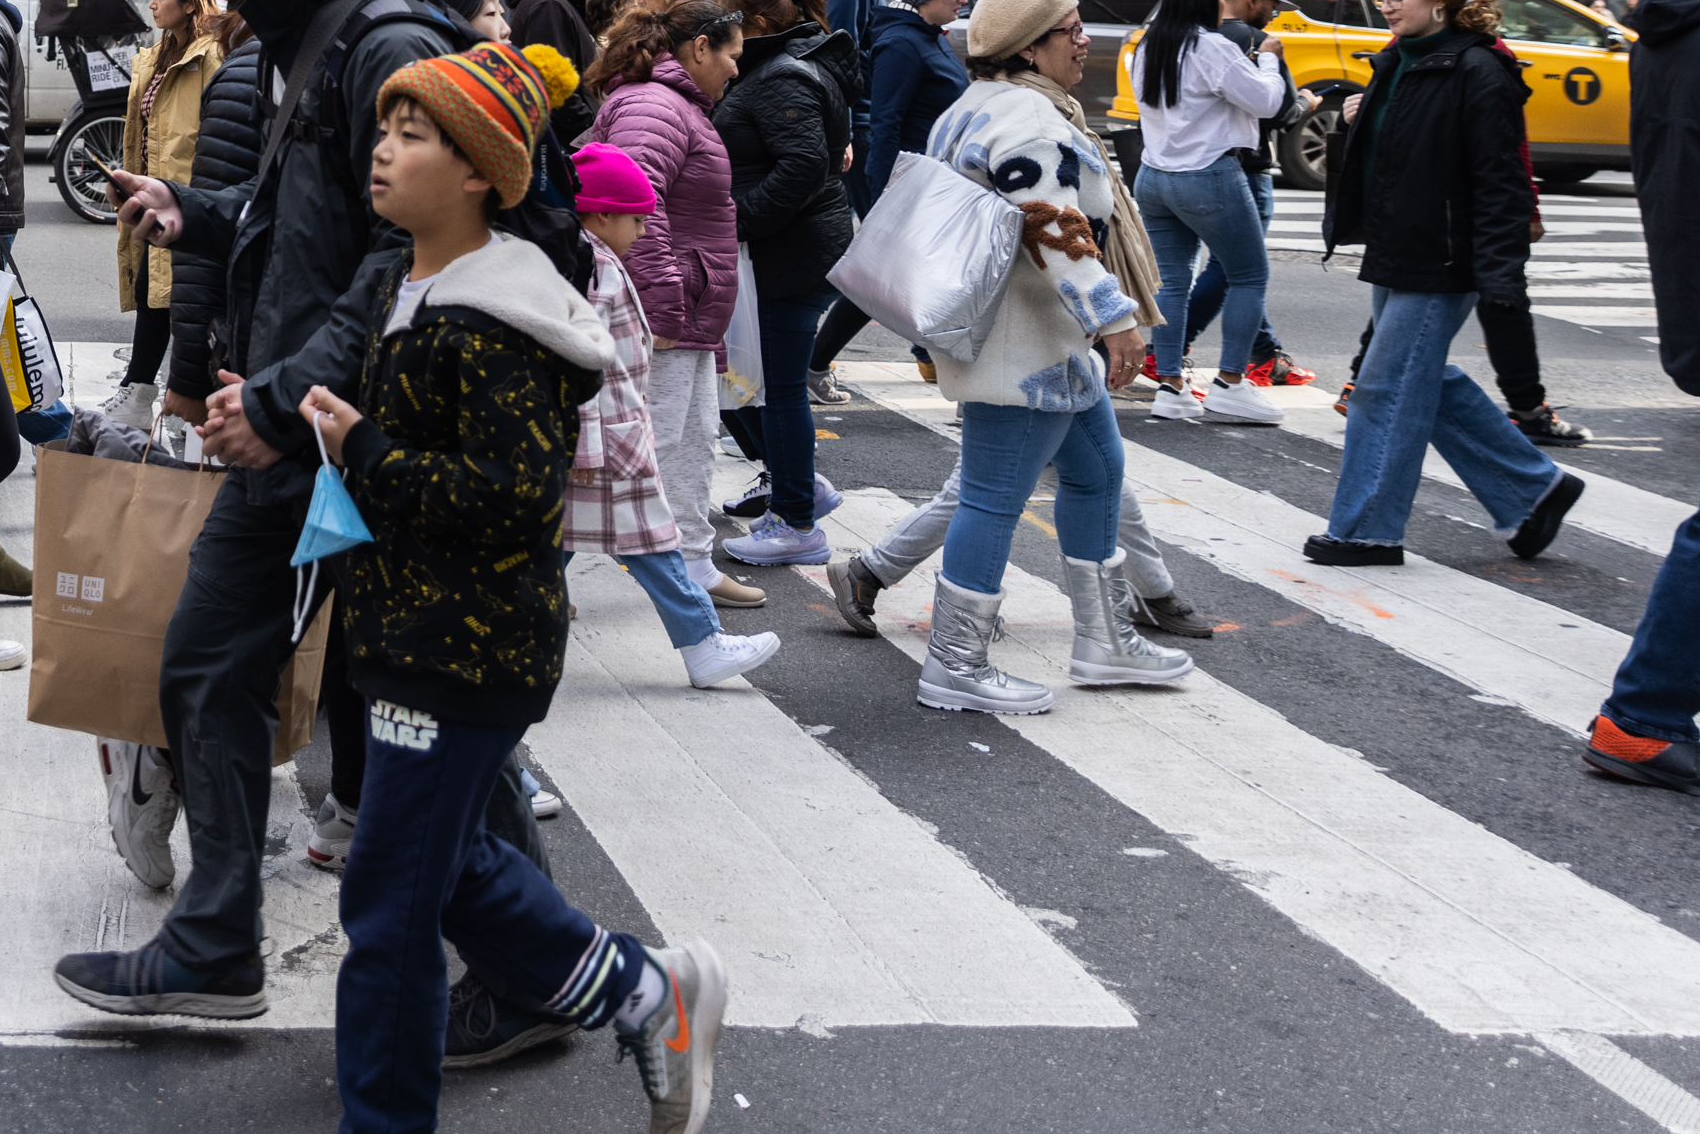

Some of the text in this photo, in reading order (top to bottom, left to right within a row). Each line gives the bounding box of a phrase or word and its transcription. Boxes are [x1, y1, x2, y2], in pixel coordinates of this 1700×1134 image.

[91, 72, 111, 83] RIDE
[1570, 73, 1595, 101] T
[527, 419, 552, 452] PIKACHU
[84, 588, 101, 598] QLO
[85, 579, 101, 588] UNI
[62, 604, 94, 616] LifeWear
[371, 698, 438, 729] STAR
[370, 714, 438, 750] WARS
